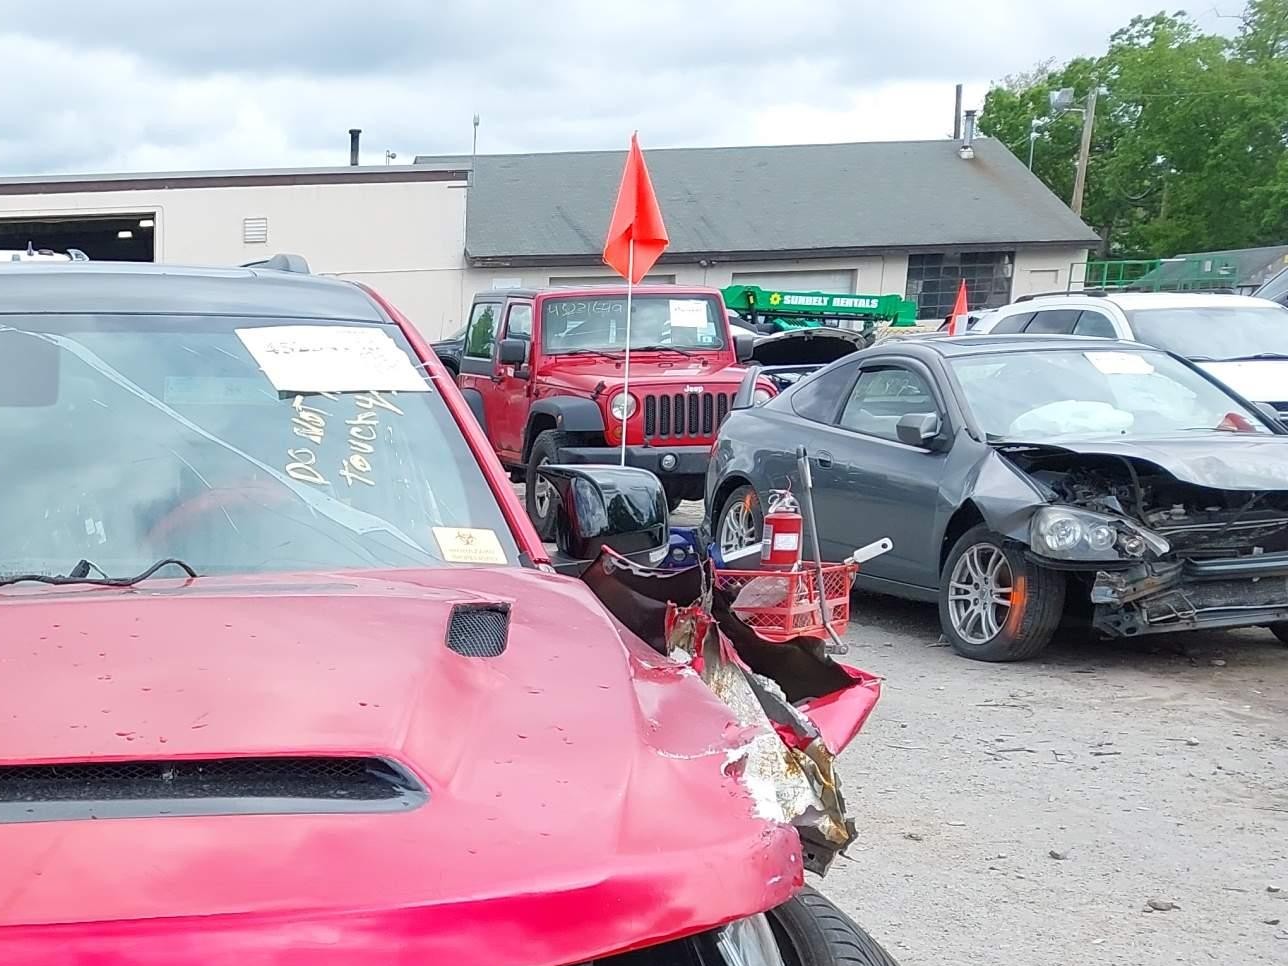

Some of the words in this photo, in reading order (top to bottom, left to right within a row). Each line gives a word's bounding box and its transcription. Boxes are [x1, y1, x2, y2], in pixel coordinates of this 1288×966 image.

[783, 295, 829, 306] SUNBELT
[832, 297, 878, 308] RENTALS
[683, 384, 704, 394] Jeep
[290, 395, 334, 446] NOT
[285, 448, 331, 485] DO
